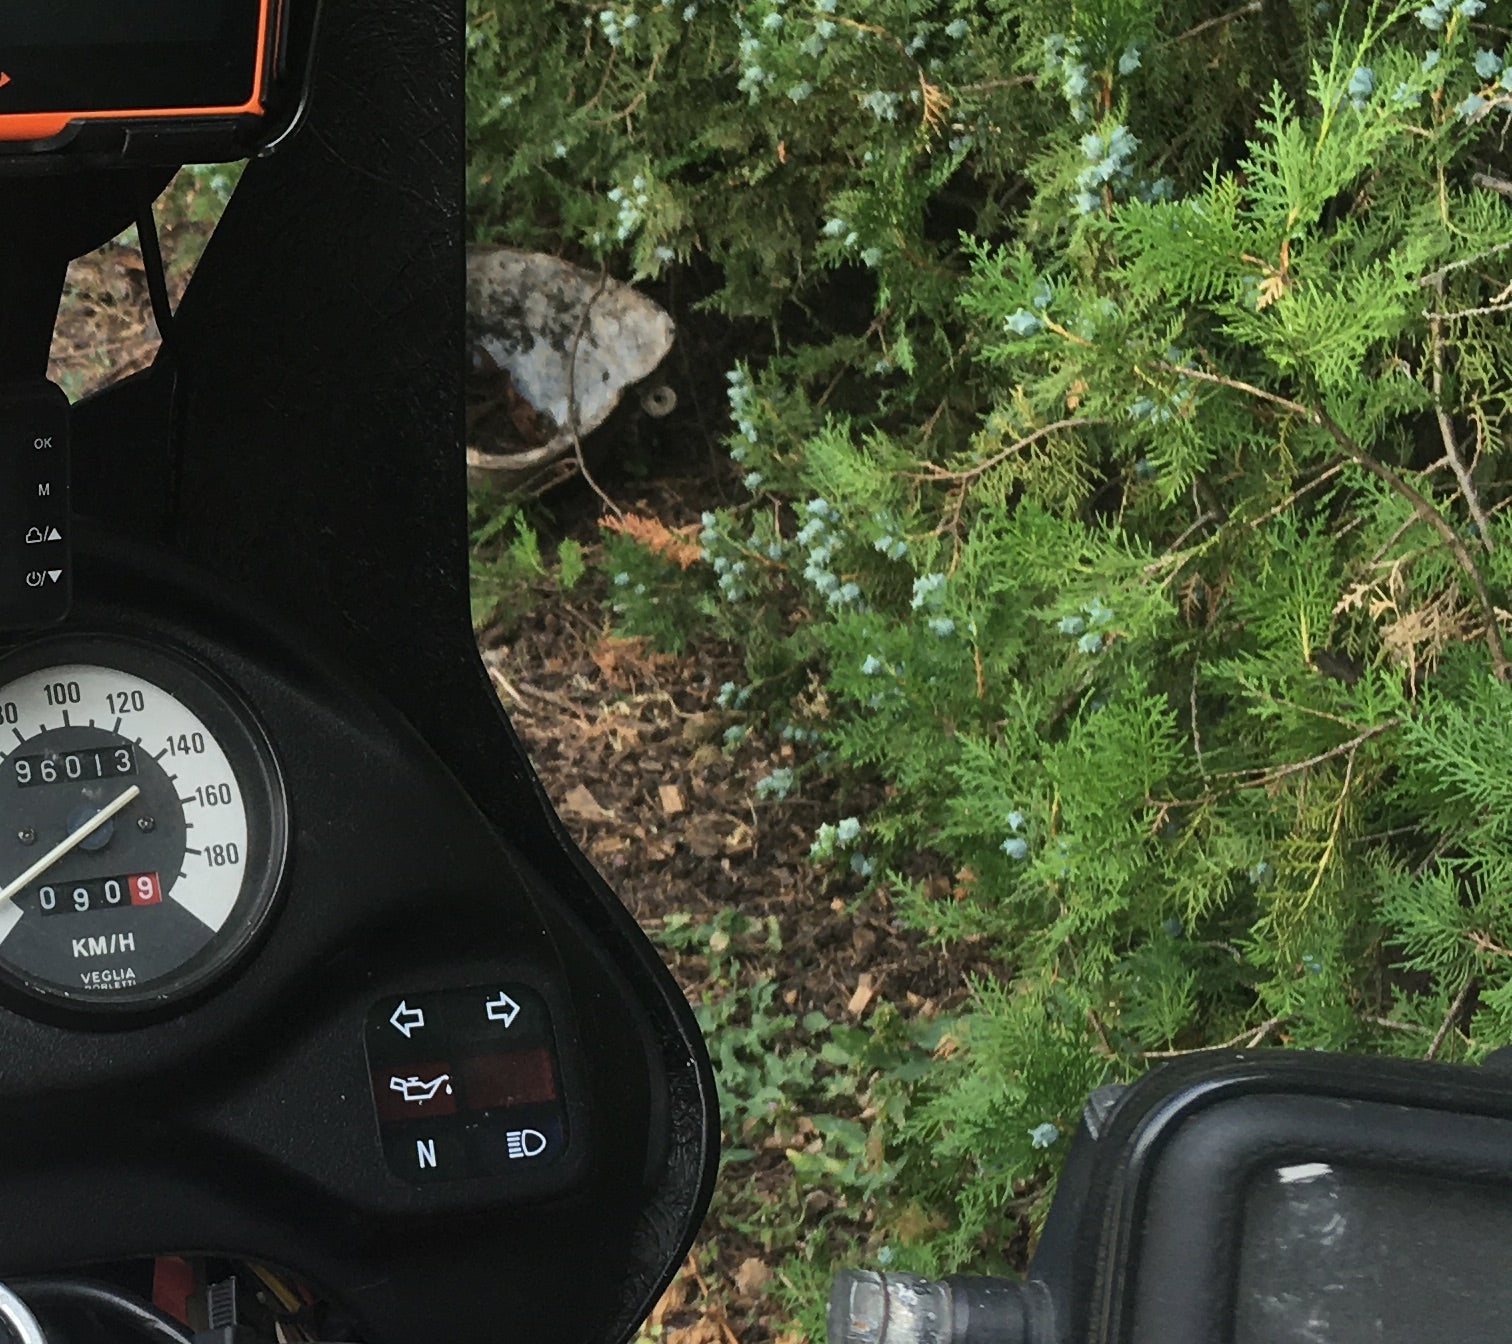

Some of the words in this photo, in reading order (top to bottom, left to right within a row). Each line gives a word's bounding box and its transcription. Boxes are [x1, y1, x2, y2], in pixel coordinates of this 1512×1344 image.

[34, 437, 52, 450] OK
[38, 483, 50, 496] M
[43, 681, 81, 706] 100
[106, 690, 145, 714] 120
[167, 732, 205, 756] 140
[15, 749, 131, 783] 96013
[195, 783, 232, 807] 160
[204, 842, 239, 867] 180
[72, 932, 136, 958] KM/H
[80, 967, 136, 985] VEGLIA
[417, 1139, 437, 1168] N
